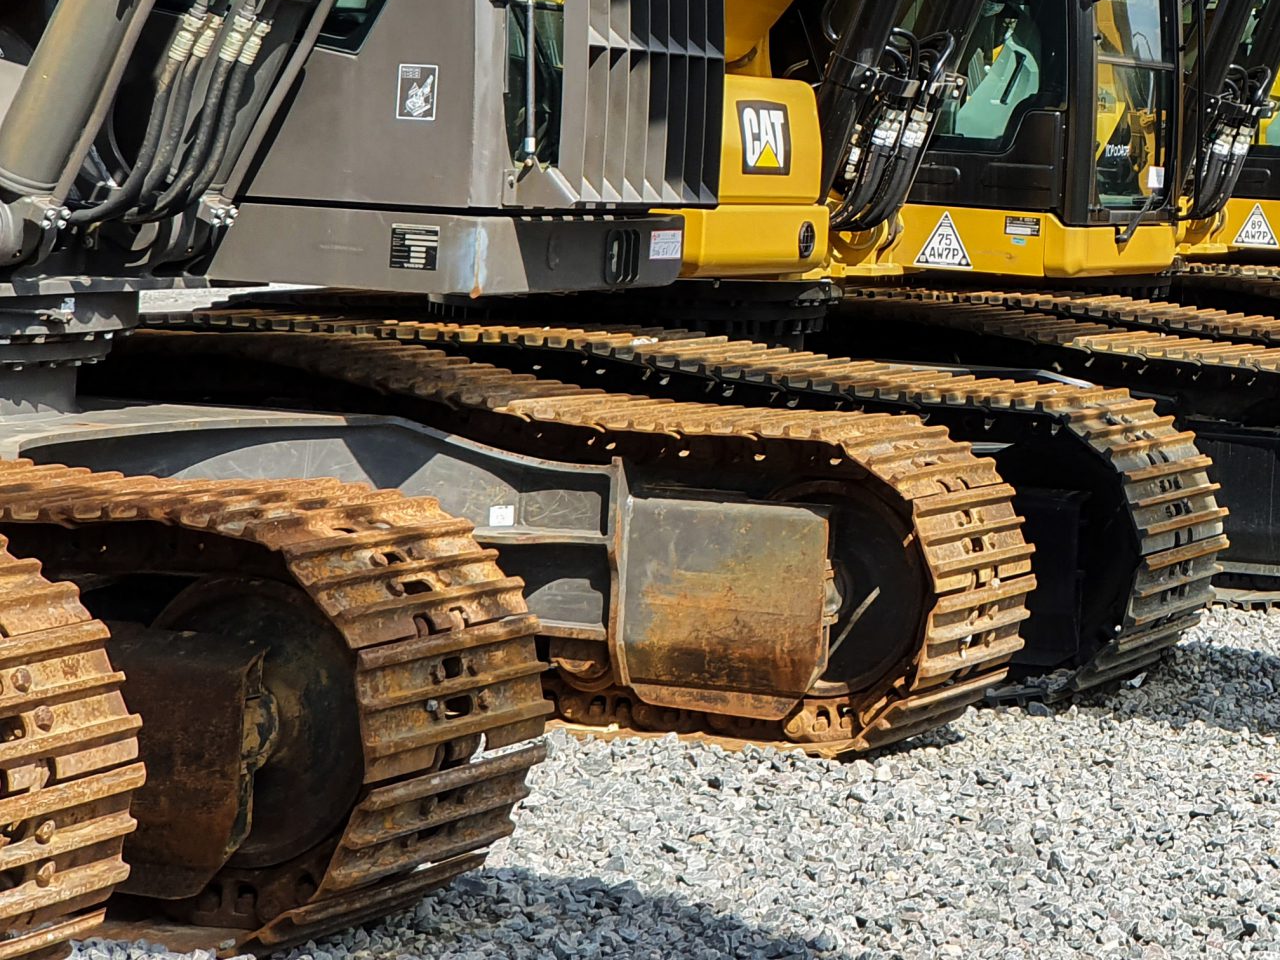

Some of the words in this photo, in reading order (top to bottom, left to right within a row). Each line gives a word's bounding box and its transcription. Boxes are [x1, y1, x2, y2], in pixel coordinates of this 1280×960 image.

[743, 107, 785, 168] CAT
[1250, 220, 1263, 230] 89
[938, 233, 953, 247] 75
[1244, 230, 1269, 241] AW7P
[929, 246, 960, 260] AW7P
